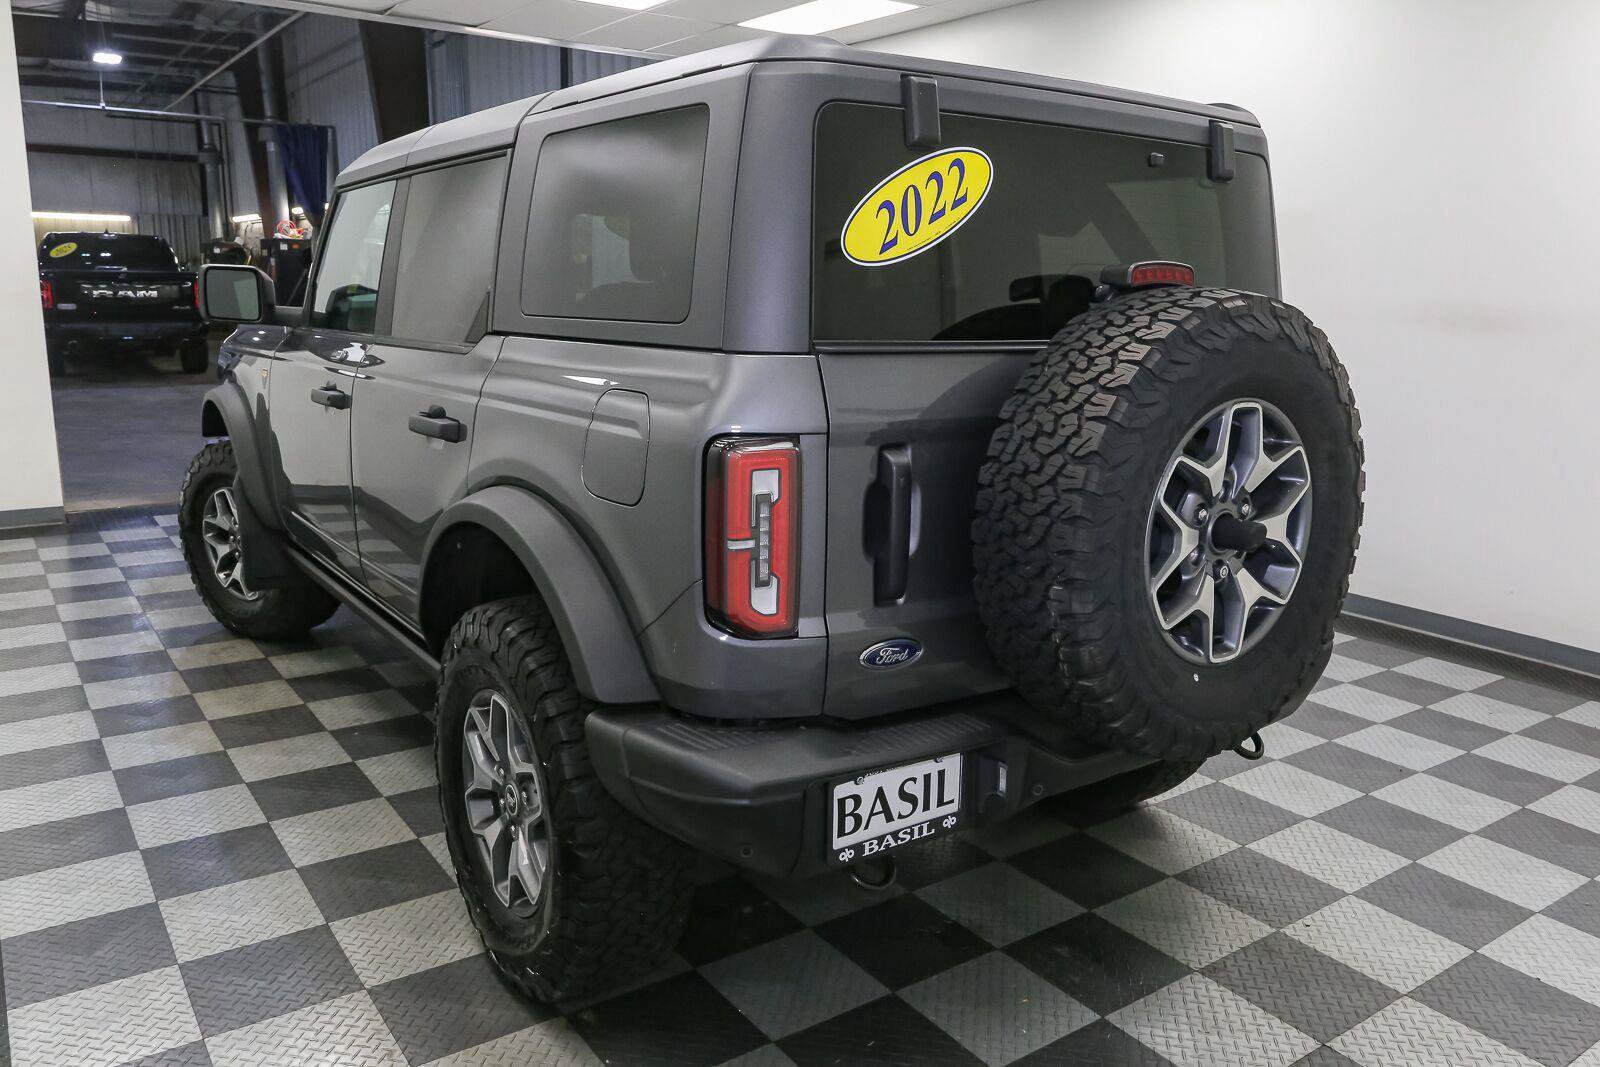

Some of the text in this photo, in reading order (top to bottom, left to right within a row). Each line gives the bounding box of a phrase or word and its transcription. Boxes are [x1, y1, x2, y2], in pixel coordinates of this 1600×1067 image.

[876, 157, 969, 255] 2022
[92, 290, 158, 298] RAM
[876, 647, 909, 664] Ford
[836, 768, 955, 839] BASIL
[862, 821, 936, 857] BASIL
